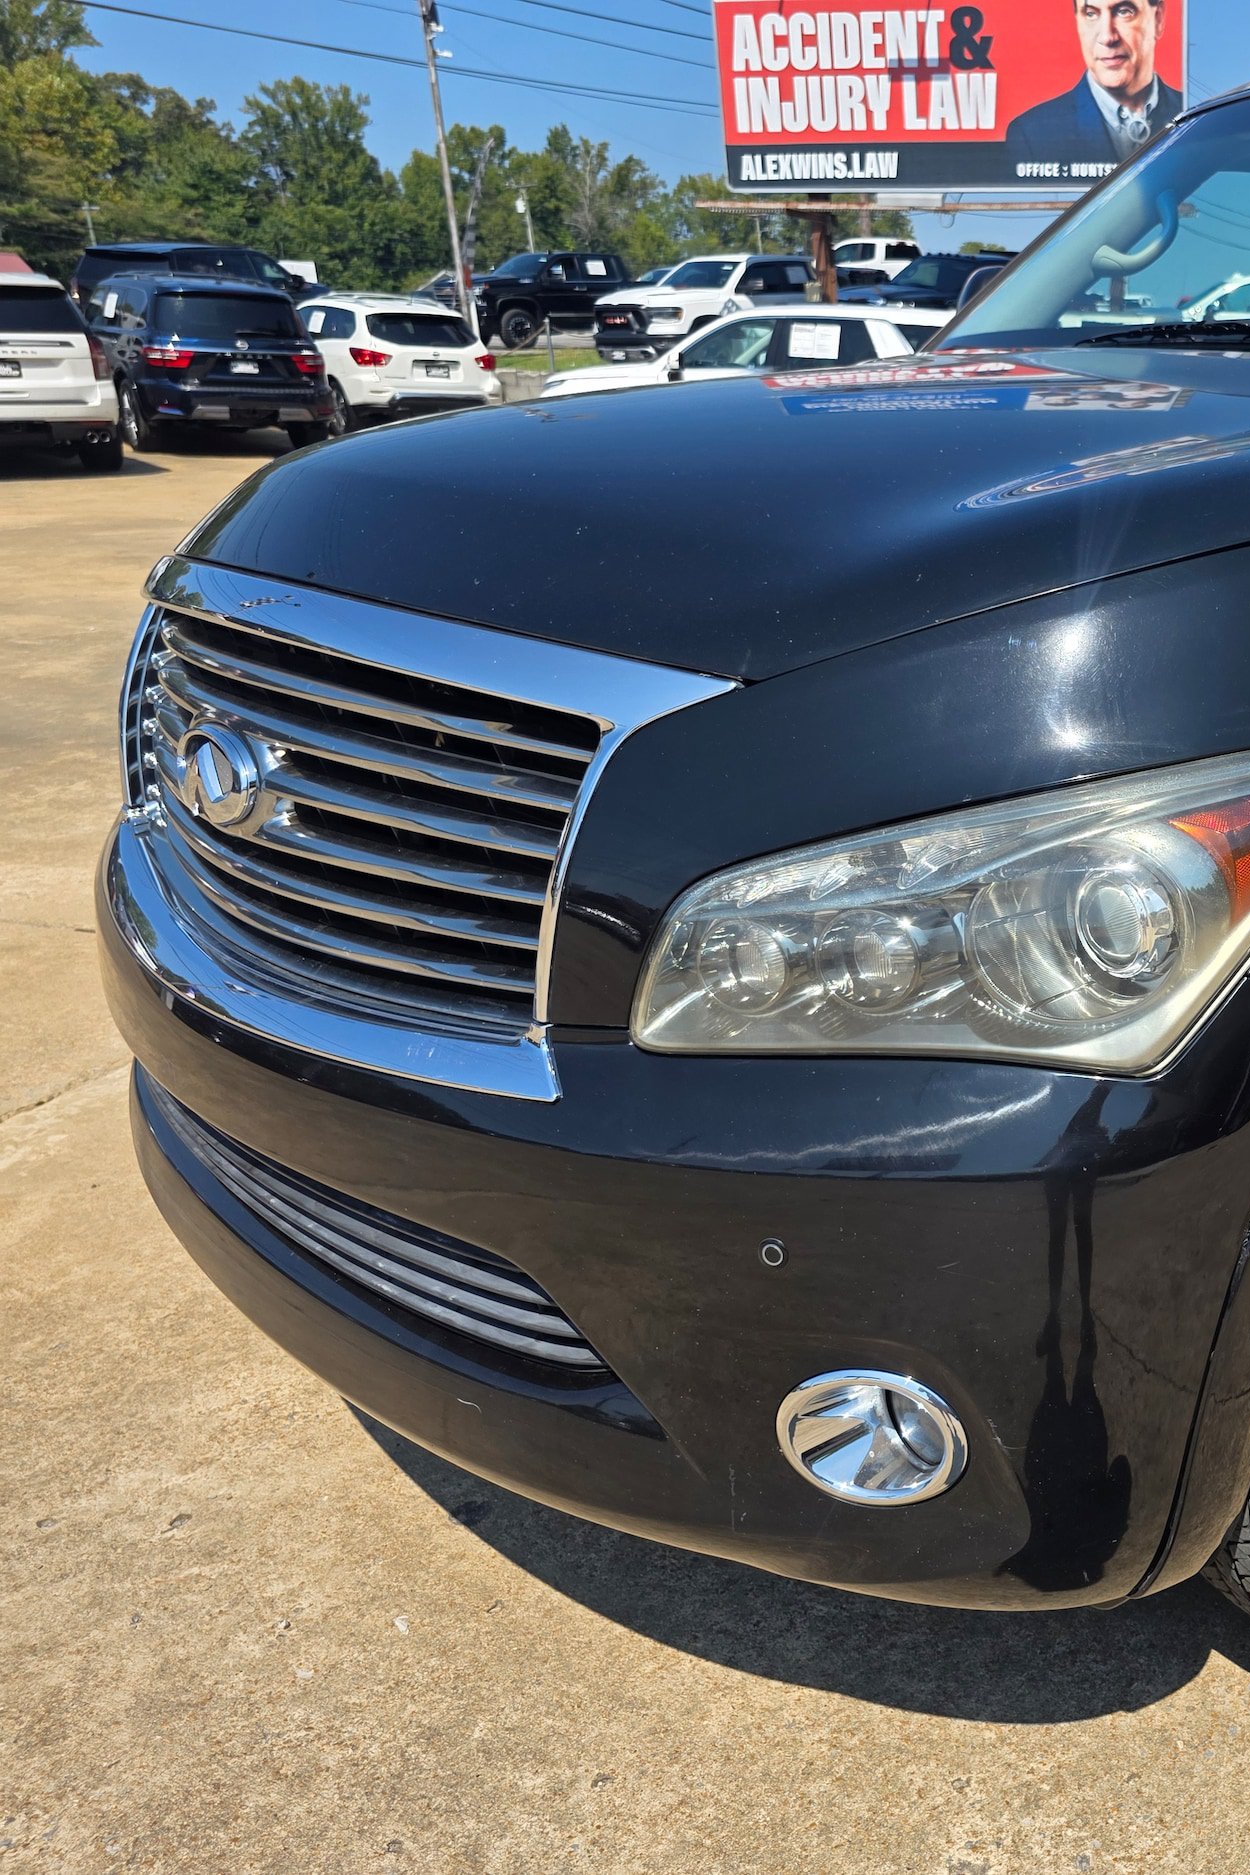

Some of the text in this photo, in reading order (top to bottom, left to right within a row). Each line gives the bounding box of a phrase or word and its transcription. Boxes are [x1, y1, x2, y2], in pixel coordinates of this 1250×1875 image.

[732, 5, 995, 72] ACCIDENT &
[733, 72, 997, 133] INJURY LAW
[740, 152, 899, 181] ALEXWINS.LAW
[1016, 163, 1060, 177] OFFICE
